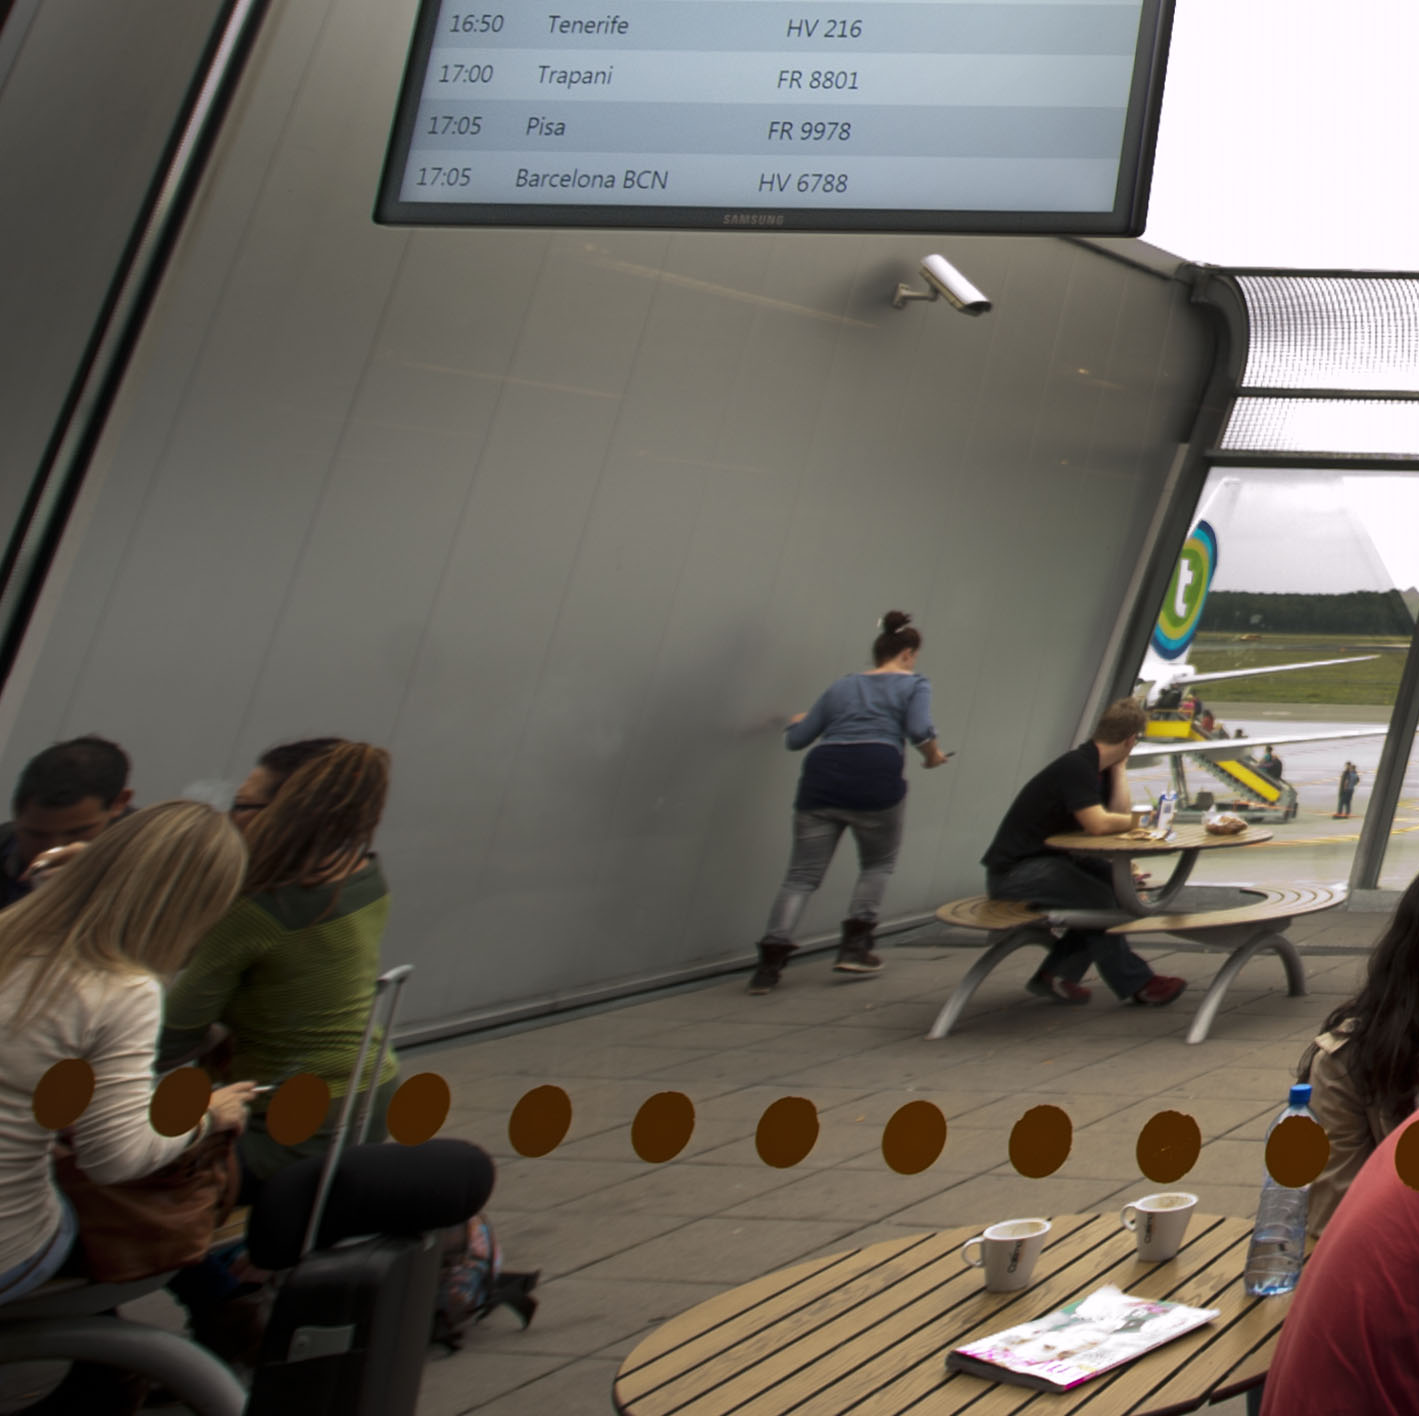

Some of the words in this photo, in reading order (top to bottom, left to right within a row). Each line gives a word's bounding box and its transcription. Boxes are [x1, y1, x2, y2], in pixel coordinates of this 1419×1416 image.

[438, 64, 494, 84] 17:00
[538, 65, 614, 90] Trapani
[777, 69, 803, 89] FR
[808, 70, 859, 90] 8801
[417, 167, 472, 187] 17:05
[515, 167, 616, 189] Barcelona
[622, 169, 669, 190] BCN
[758, 173, 792, 193] HV
[796, 173, 849, 194] 6788
[723, 214, 784, 226] SAMSUNG
[1175, 559, 1194, 618] t
